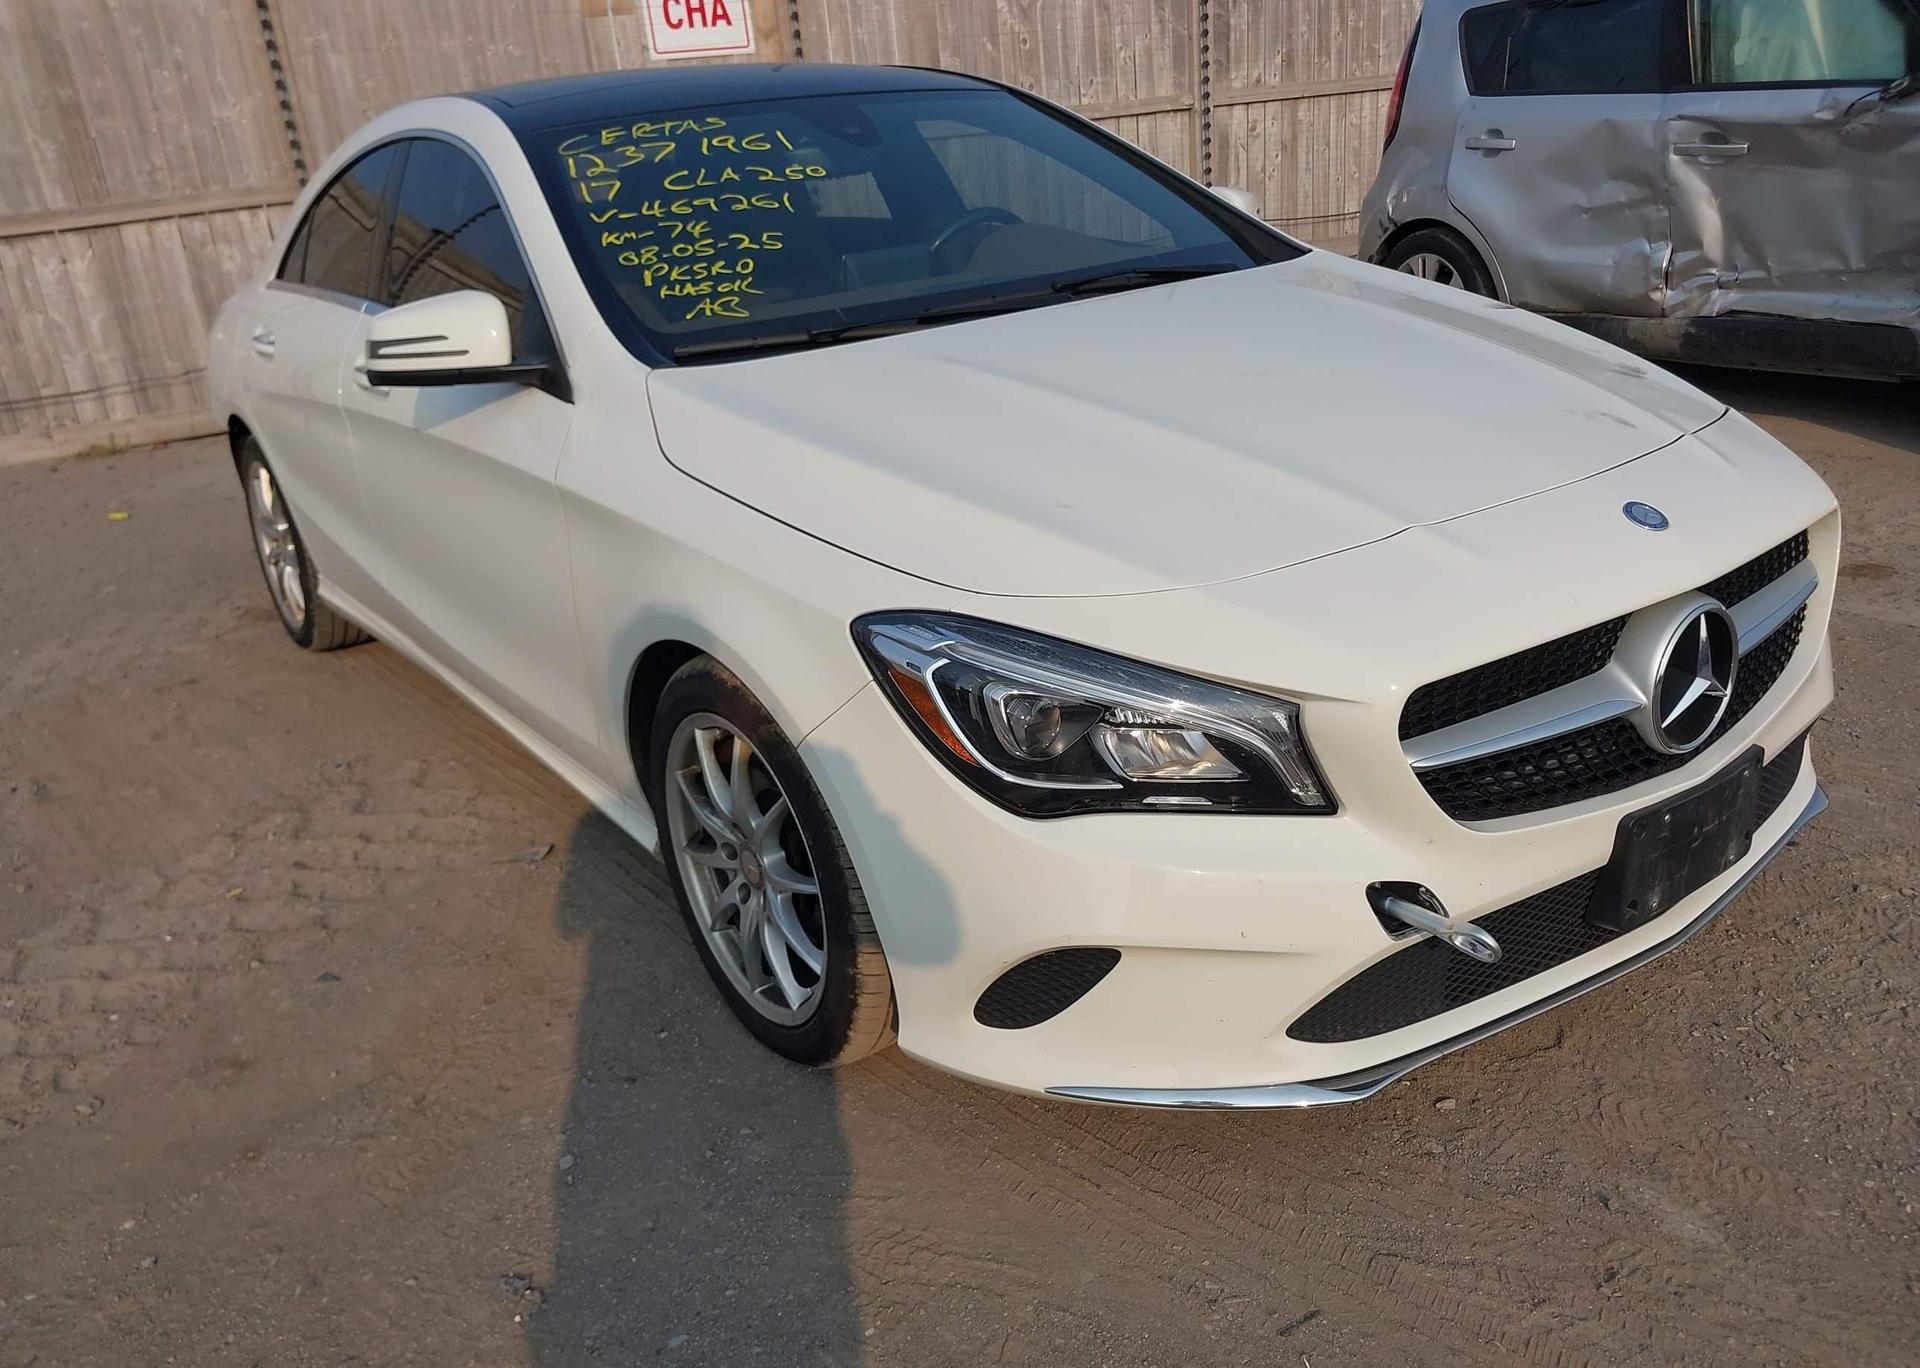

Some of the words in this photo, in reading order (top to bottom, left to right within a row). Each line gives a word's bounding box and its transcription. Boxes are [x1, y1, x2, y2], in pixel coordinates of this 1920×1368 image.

[662, 0, 733, 30] CHA
[567, 140, 677, 179] 1237
[700, 129, 794, 156] 1961
[579, 179, 622, 204] 17
